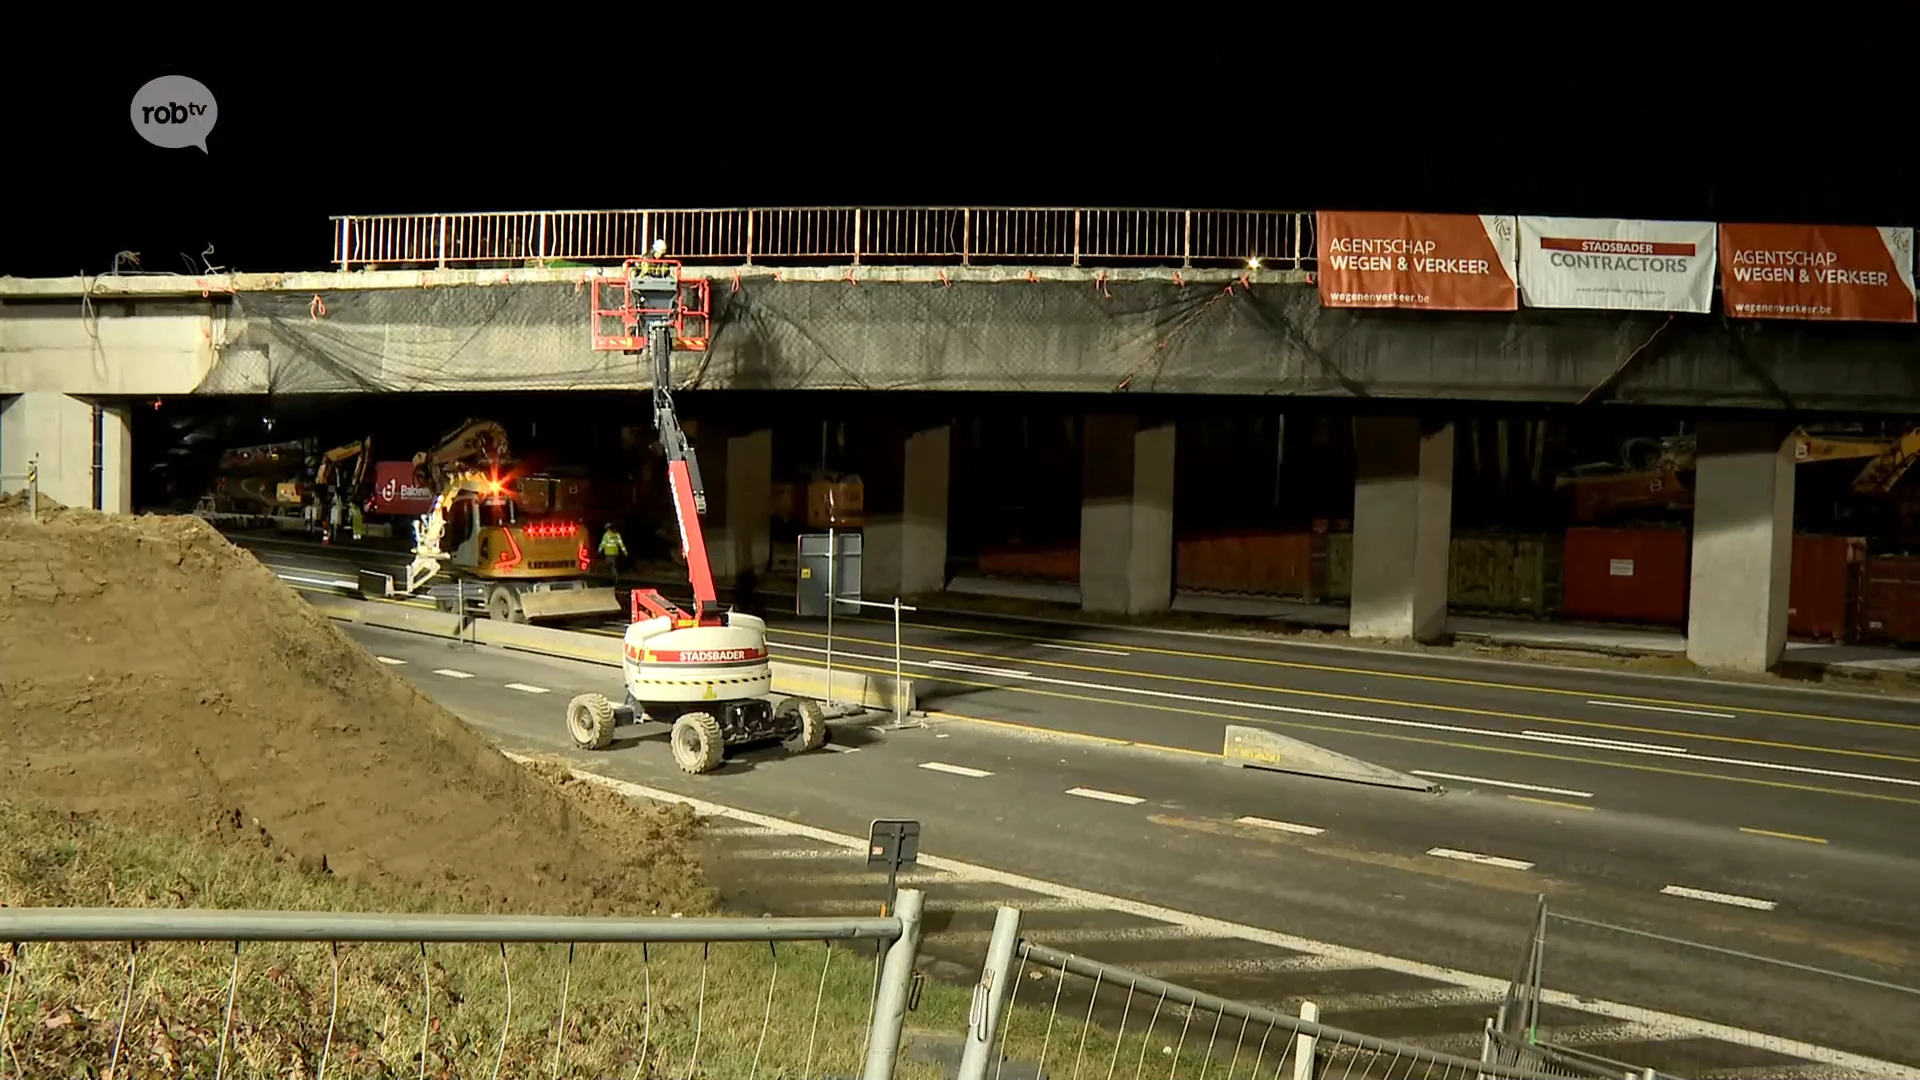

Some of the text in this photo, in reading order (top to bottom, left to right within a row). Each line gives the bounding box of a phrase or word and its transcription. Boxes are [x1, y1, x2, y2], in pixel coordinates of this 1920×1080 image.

[1329, 238, 1436, 255] AGENTSCHAP
[1581, 241, 1653, 254] STADSBADER
[1330, 255, 1489, 275] WEGEN & VERKEER
[1550, 252, 1688, 273] CONTRACTORS
[1733, 250, 1837, 266] AGENTSCHAP
[1733, 267, 1888, 287] WEGEN & VERKEER
[1330, 292, 1430, 304] wegenenverkeer.be
[1735, 303, 1832, 315] wegenenverkeer.be
[679, 650, 745, 662] STADSBADER
